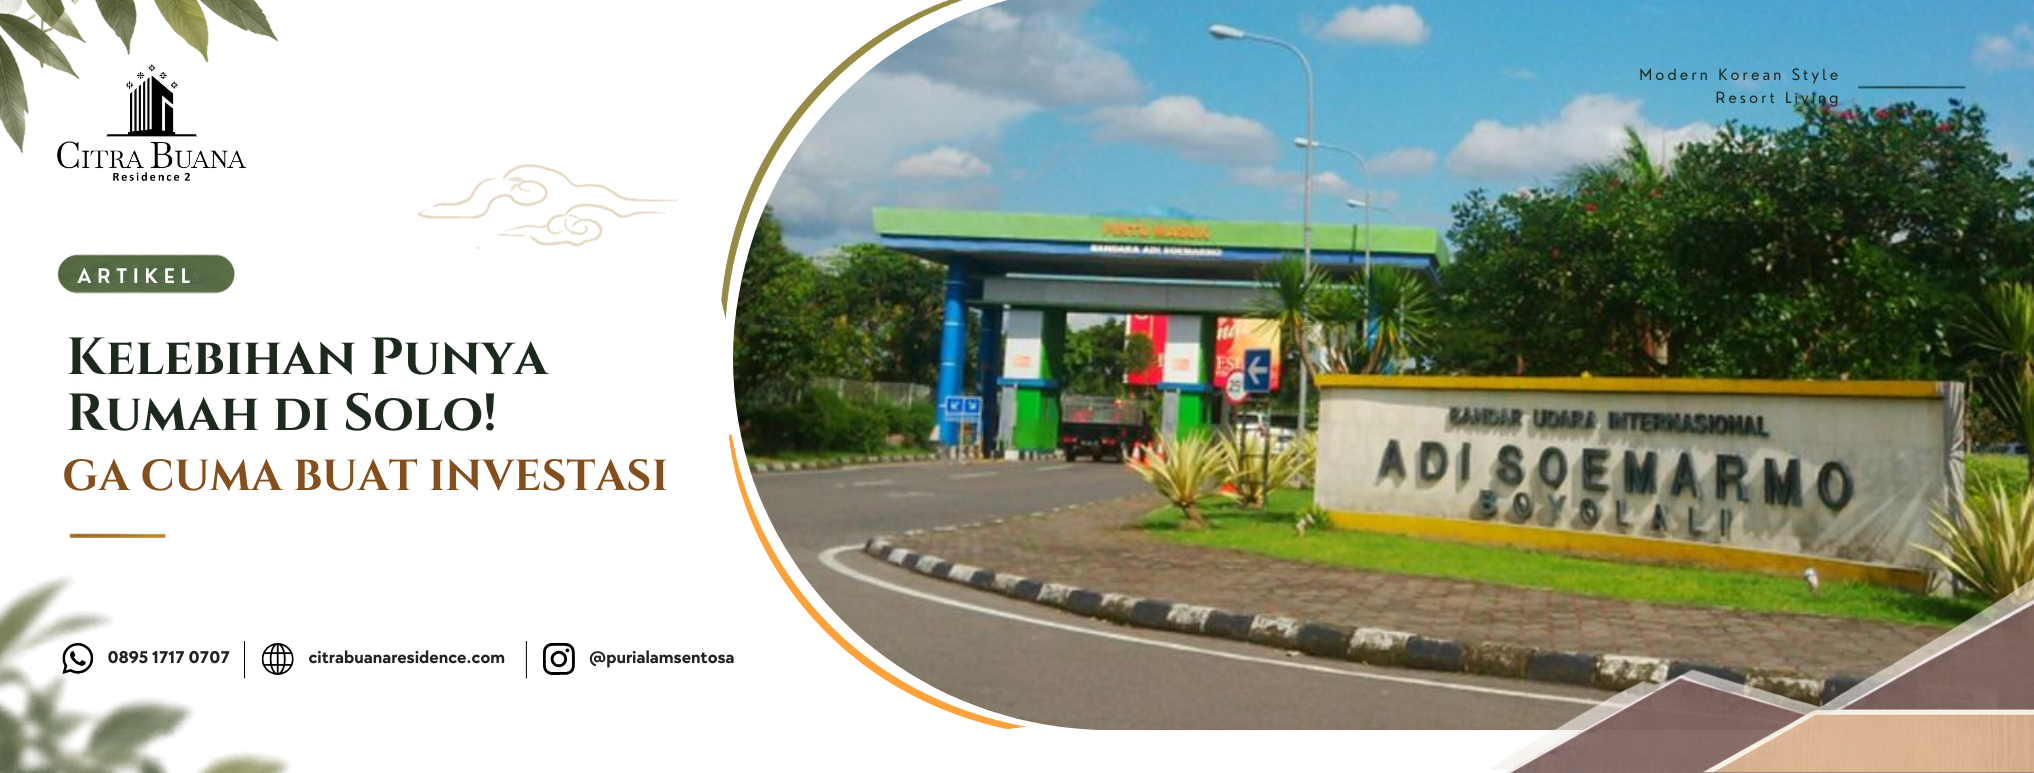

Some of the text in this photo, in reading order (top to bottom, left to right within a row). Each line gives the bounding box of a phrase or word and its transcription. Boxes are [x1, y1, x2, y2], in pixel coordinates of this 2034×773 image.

[1449, 405, 1769, 437] BANDAR UDARA INTERNASIONAL
[1377, 439, 1854, 511] ADI SOEMARMO
